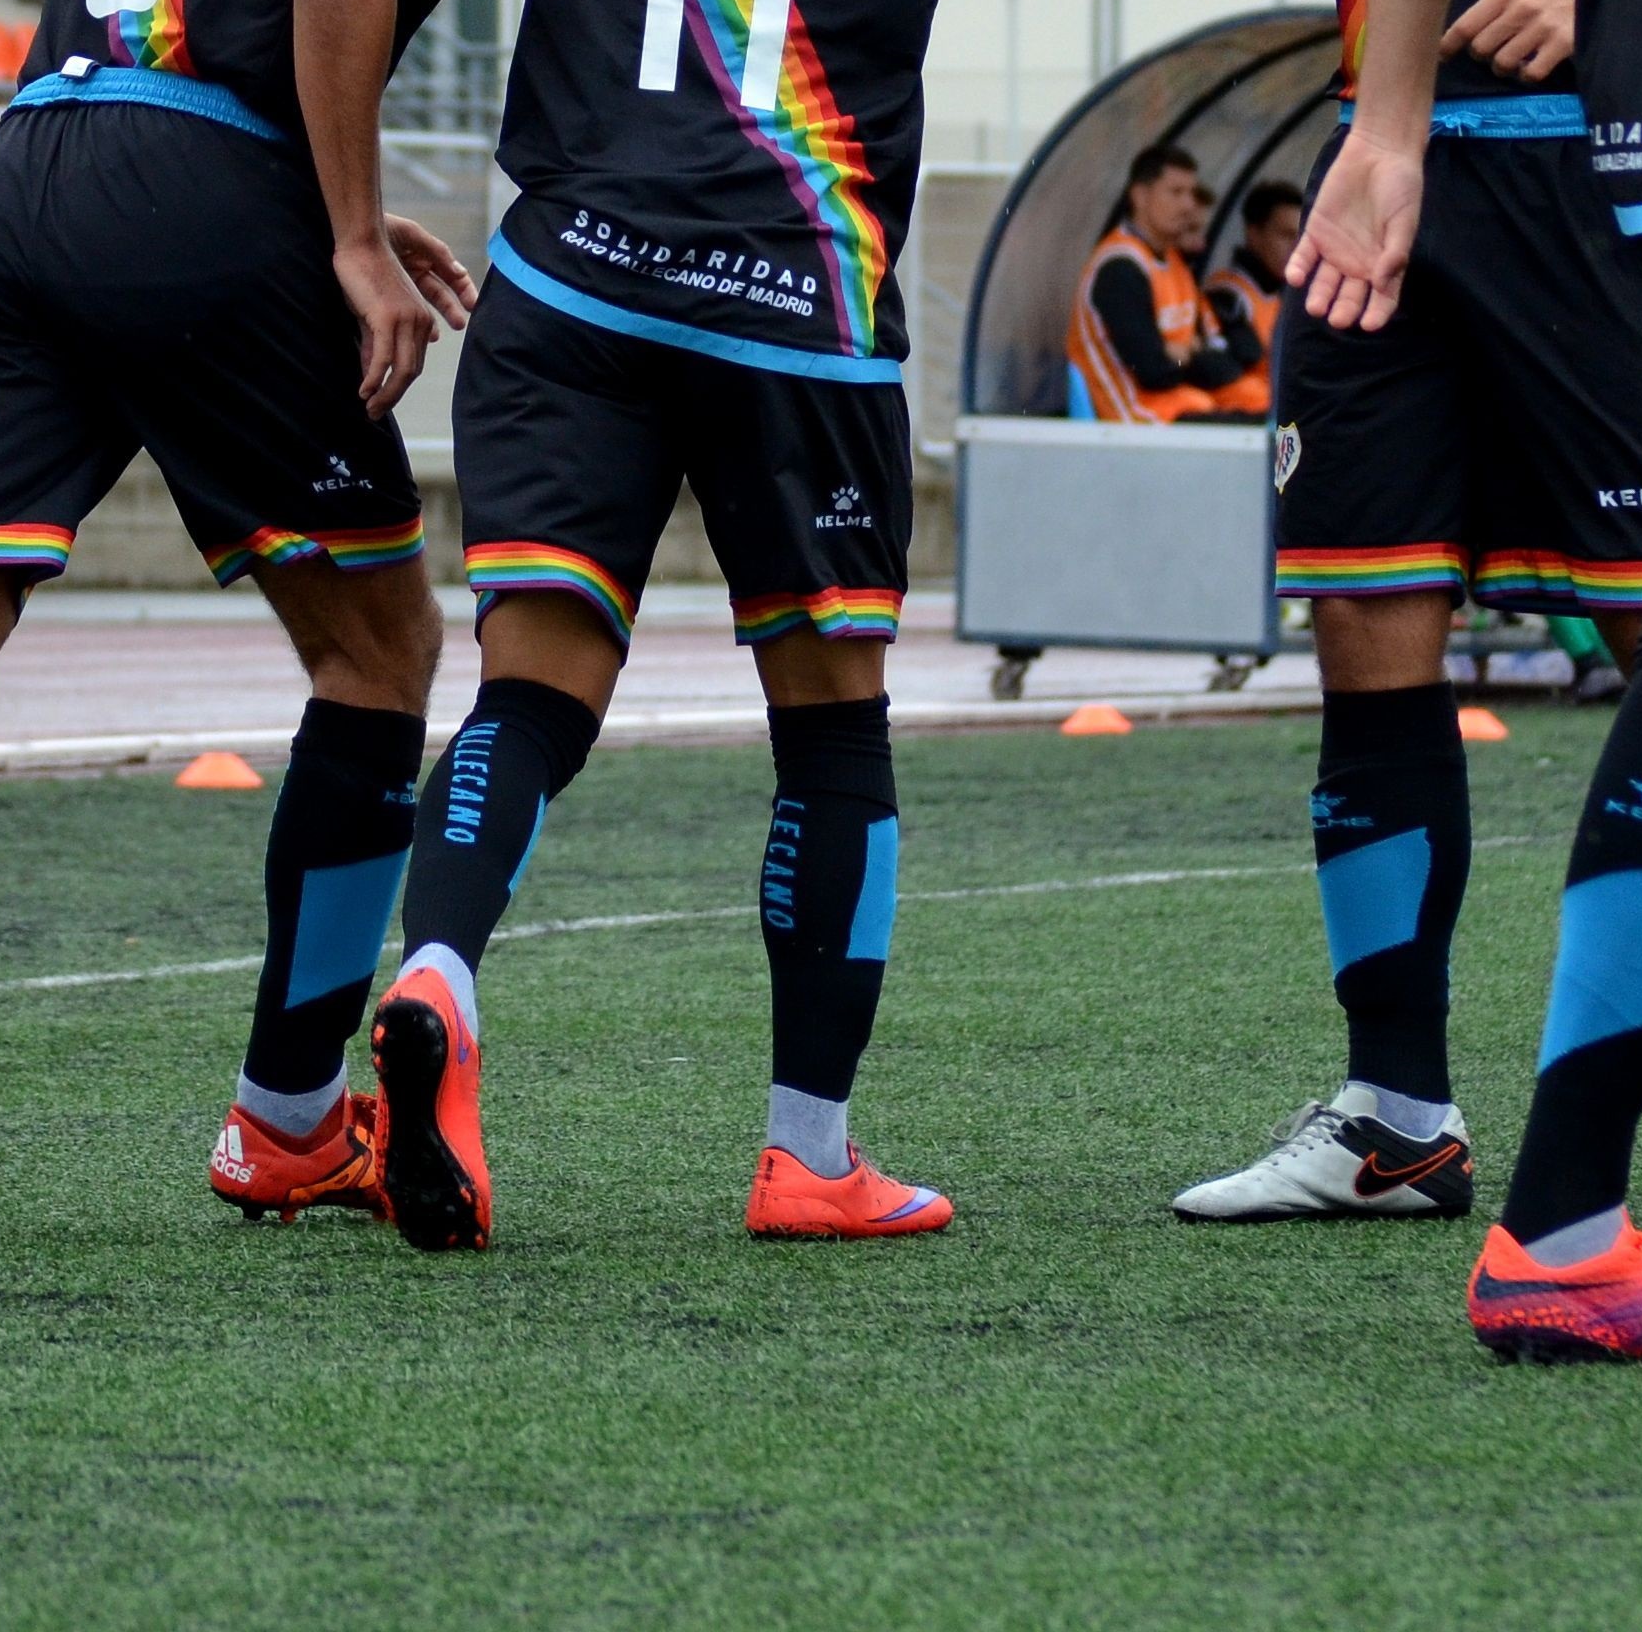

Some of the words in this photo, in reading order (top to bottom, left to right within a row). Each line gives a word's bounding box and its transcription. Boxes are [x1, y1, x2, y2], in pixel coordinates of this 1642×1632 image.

[560, 230, 607, 255] RAYO
[608, 250, 716, 290] VALLECANO
[717, 278, 745, 297] DE
[746, 285, 813, 317] MADRID
[574, 210, 816, 294] SOLIDARIDAD
[816, 515, 872, 528] KELME
